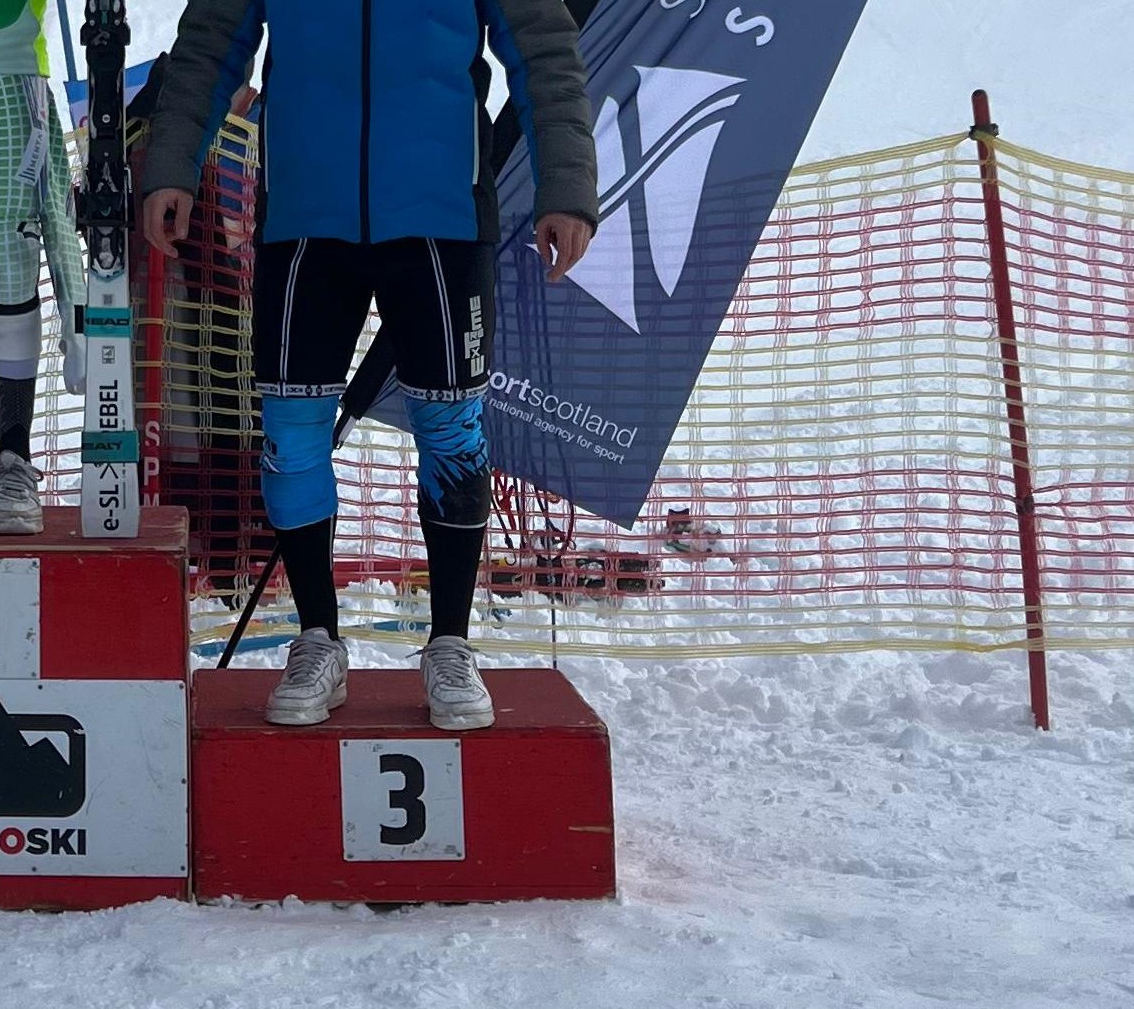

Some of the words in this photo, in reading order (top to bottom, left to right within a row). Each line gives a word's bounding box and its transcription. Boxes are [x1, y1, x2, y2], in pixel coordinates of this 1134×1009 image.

[98, 379, 120, 433] EBEL
[487, 369, 639, 449] ortscotland
[488, 397, 535, 424] national
[534, 417, 576, 444] agency
[576, 434, 594, 450] for
[593, 443, 626, 466] sport
[378, 753, 427, 846] 3
